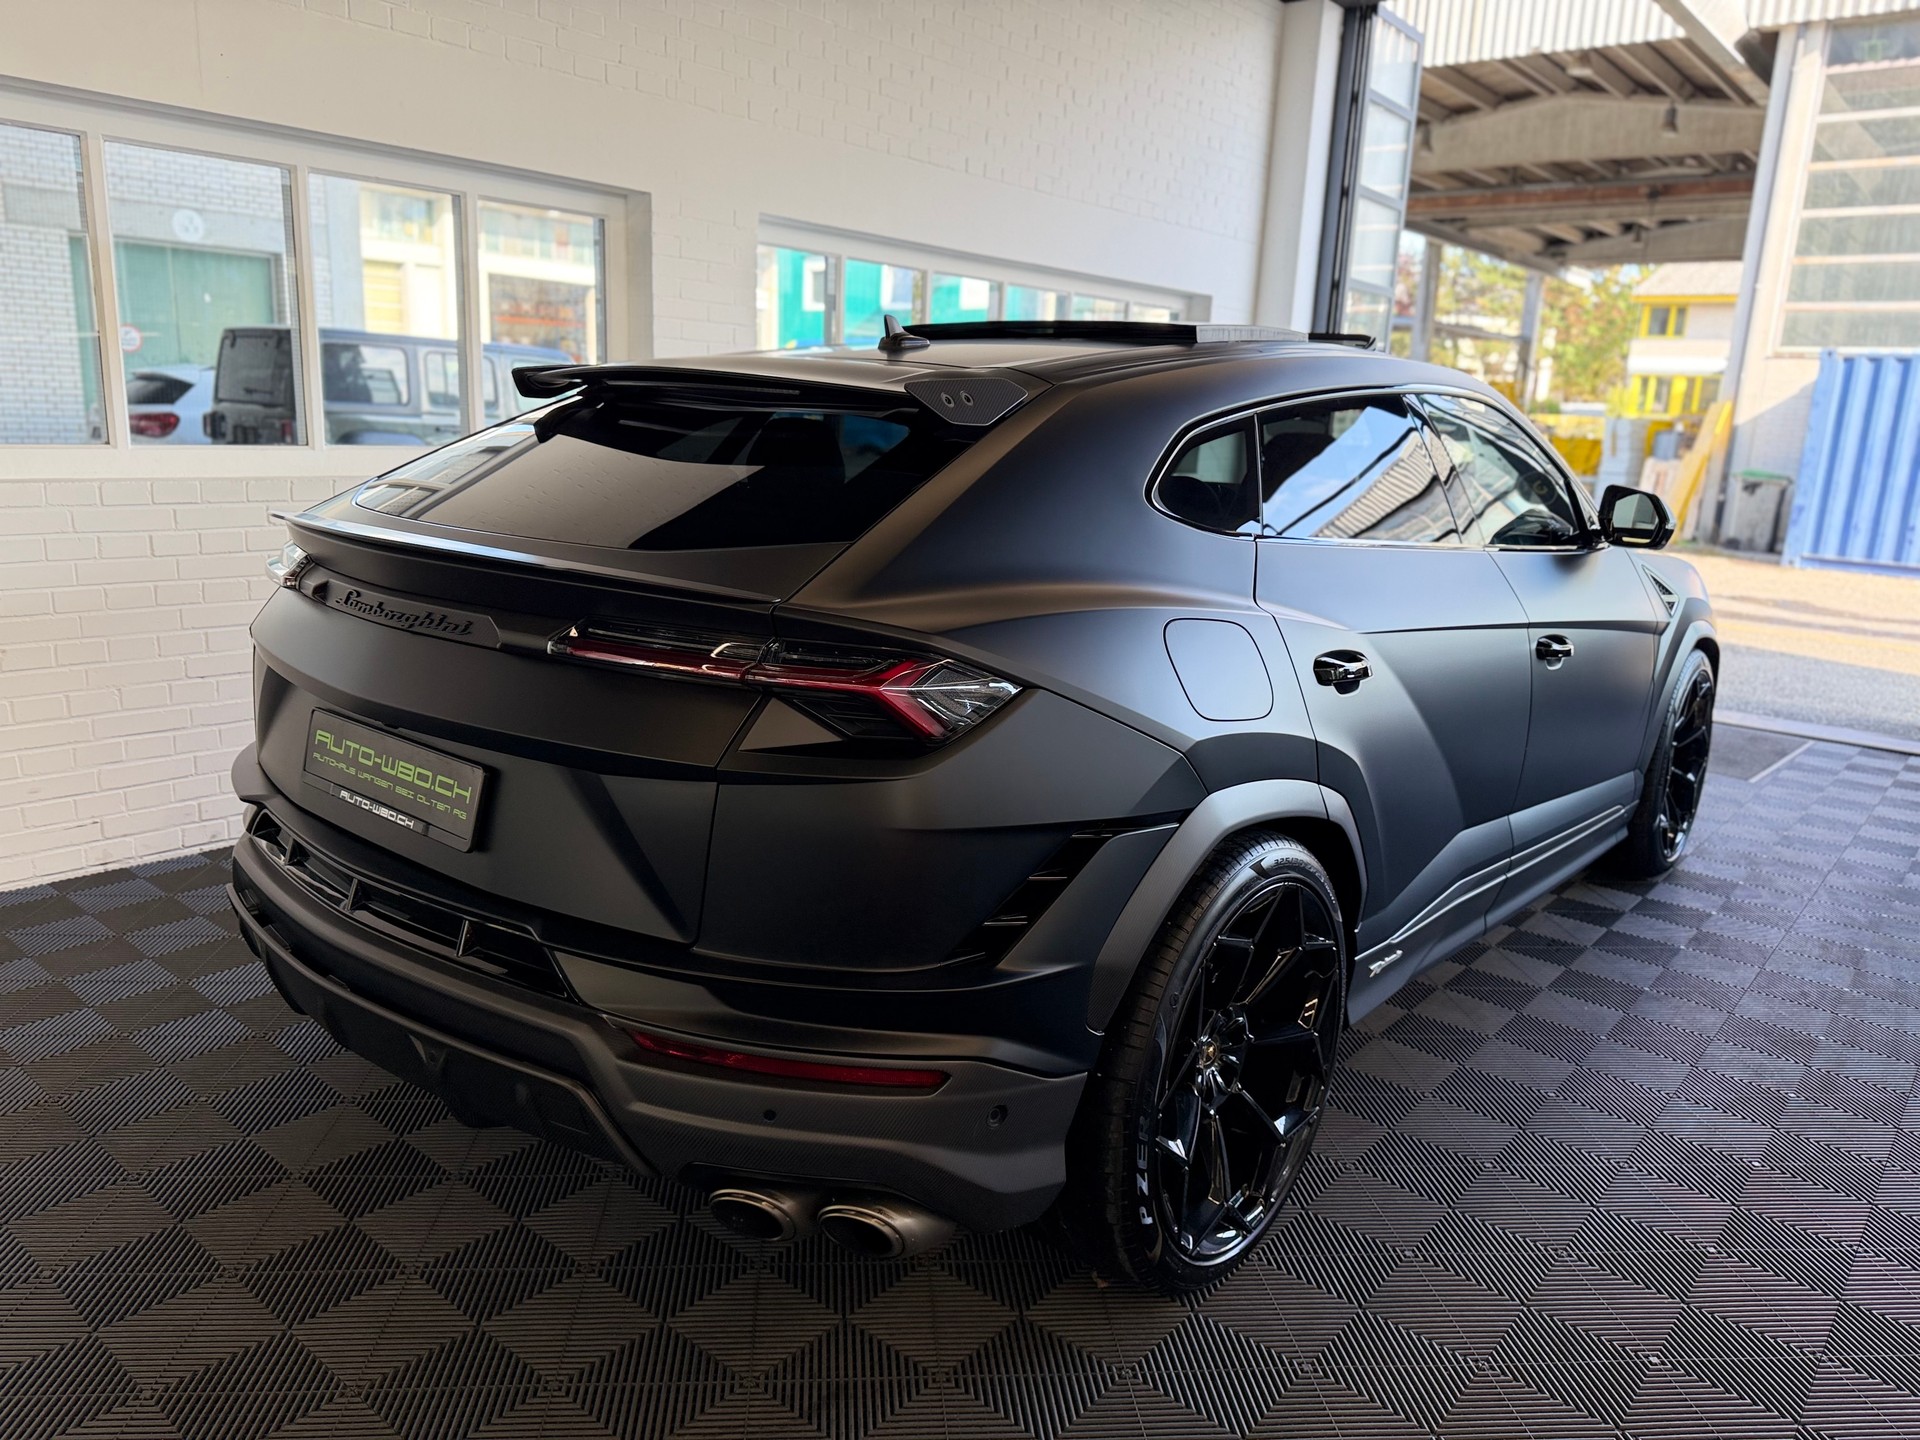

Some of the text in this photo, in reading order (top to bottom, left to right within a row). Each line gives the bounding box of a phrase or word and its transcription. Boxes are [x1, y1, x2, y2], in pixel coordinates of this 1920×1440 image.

[335, 589, 473, 636] Lamborghini
[357, 769, 393, 791] WANGEN
[394, 785, 415, 800] BEI
[416, 793, 451, 815] OLTEN
[452, 807, 467, 820] AG
